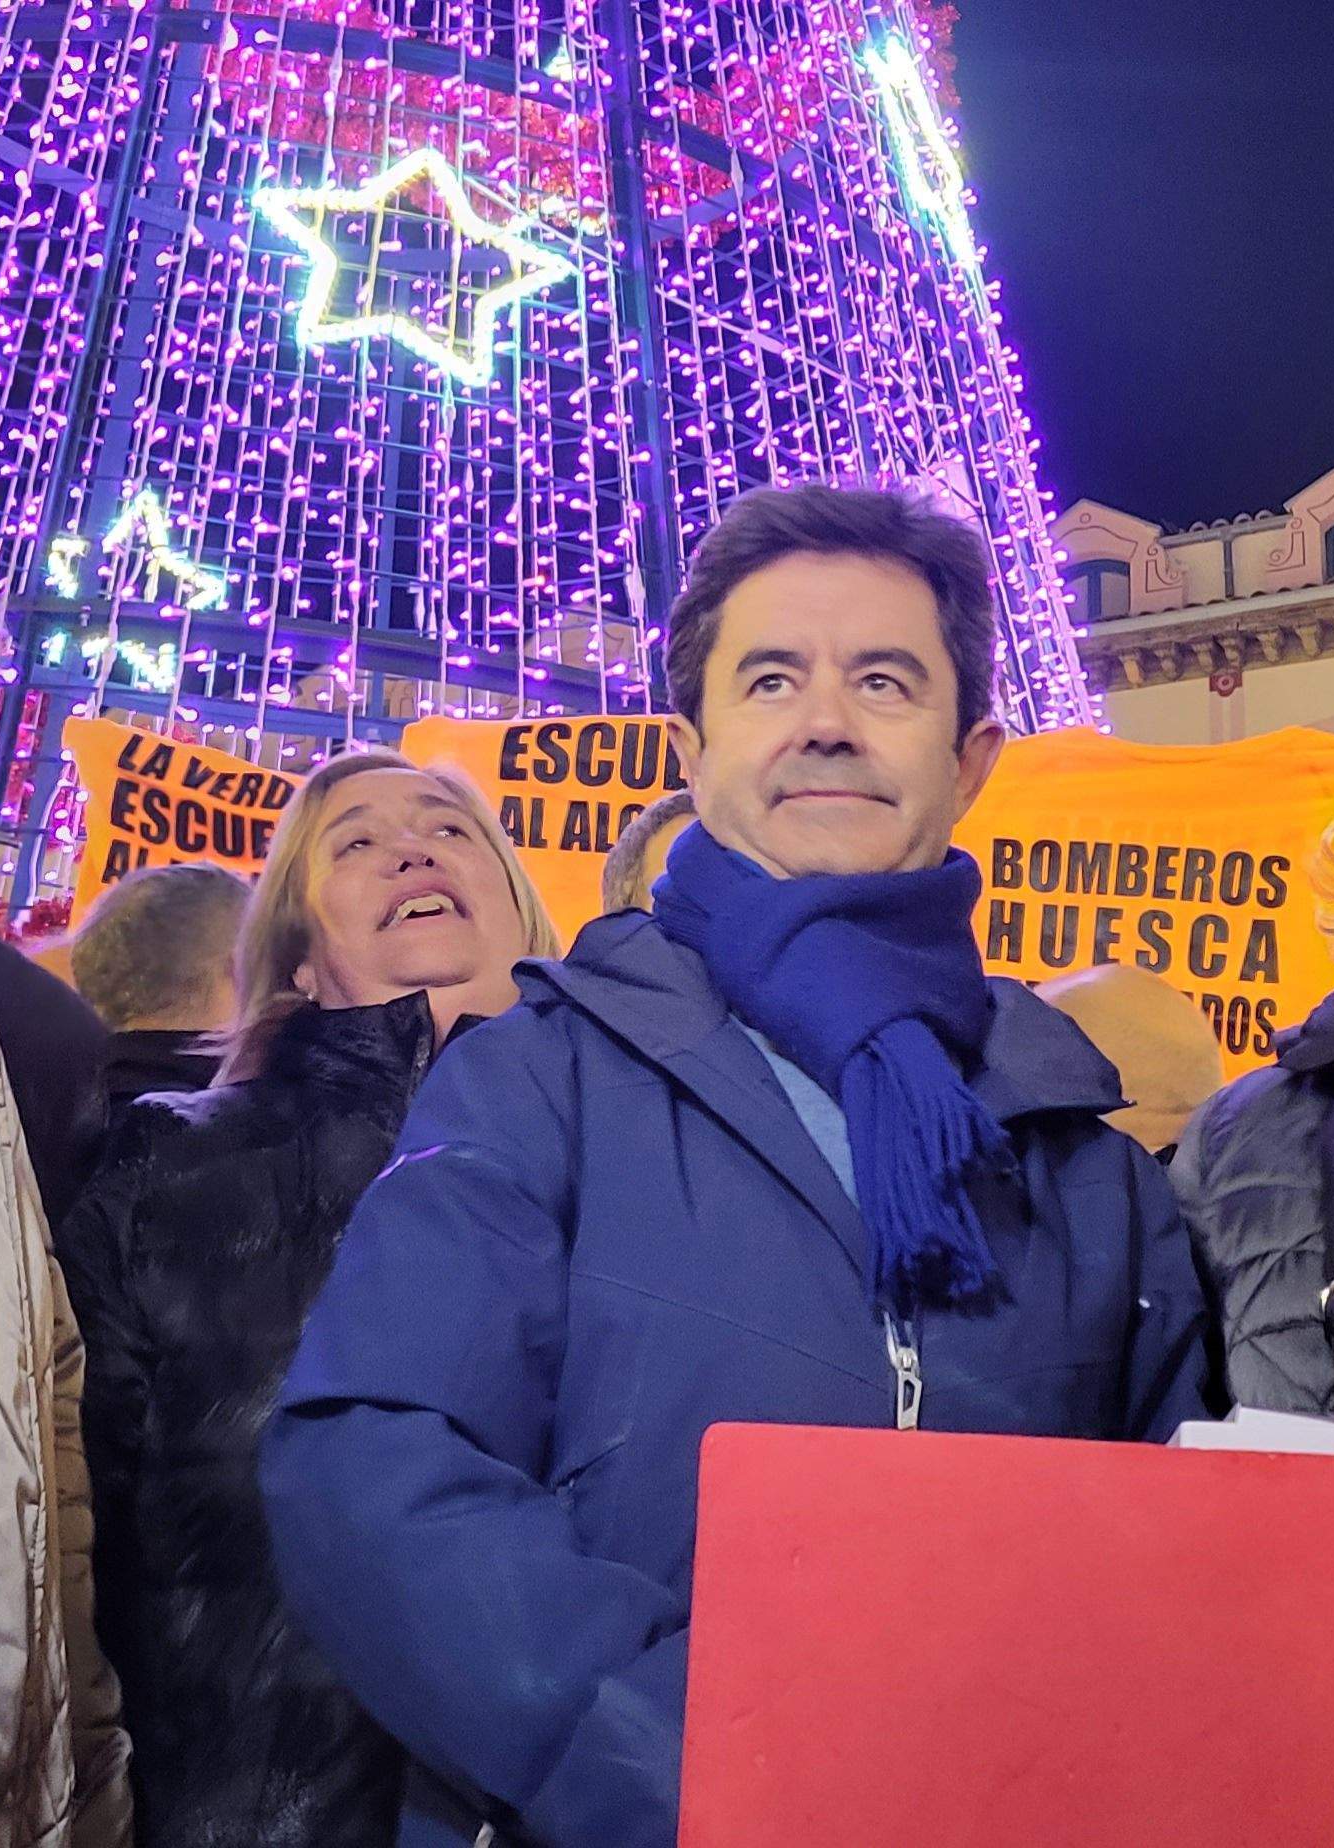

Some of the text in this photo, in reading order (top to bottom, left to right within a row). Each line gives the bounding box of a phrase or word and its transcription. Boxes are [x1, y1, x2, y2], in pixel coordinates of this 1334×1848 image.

[117, 733, 176, 781] LA
[499, 795, 547, 848] AL
[991, 838, 1291, 908] BOMBEROS
[985, 899, 1281, 984] HUESCA
[1179, 991, 1278, 1057] DOS
